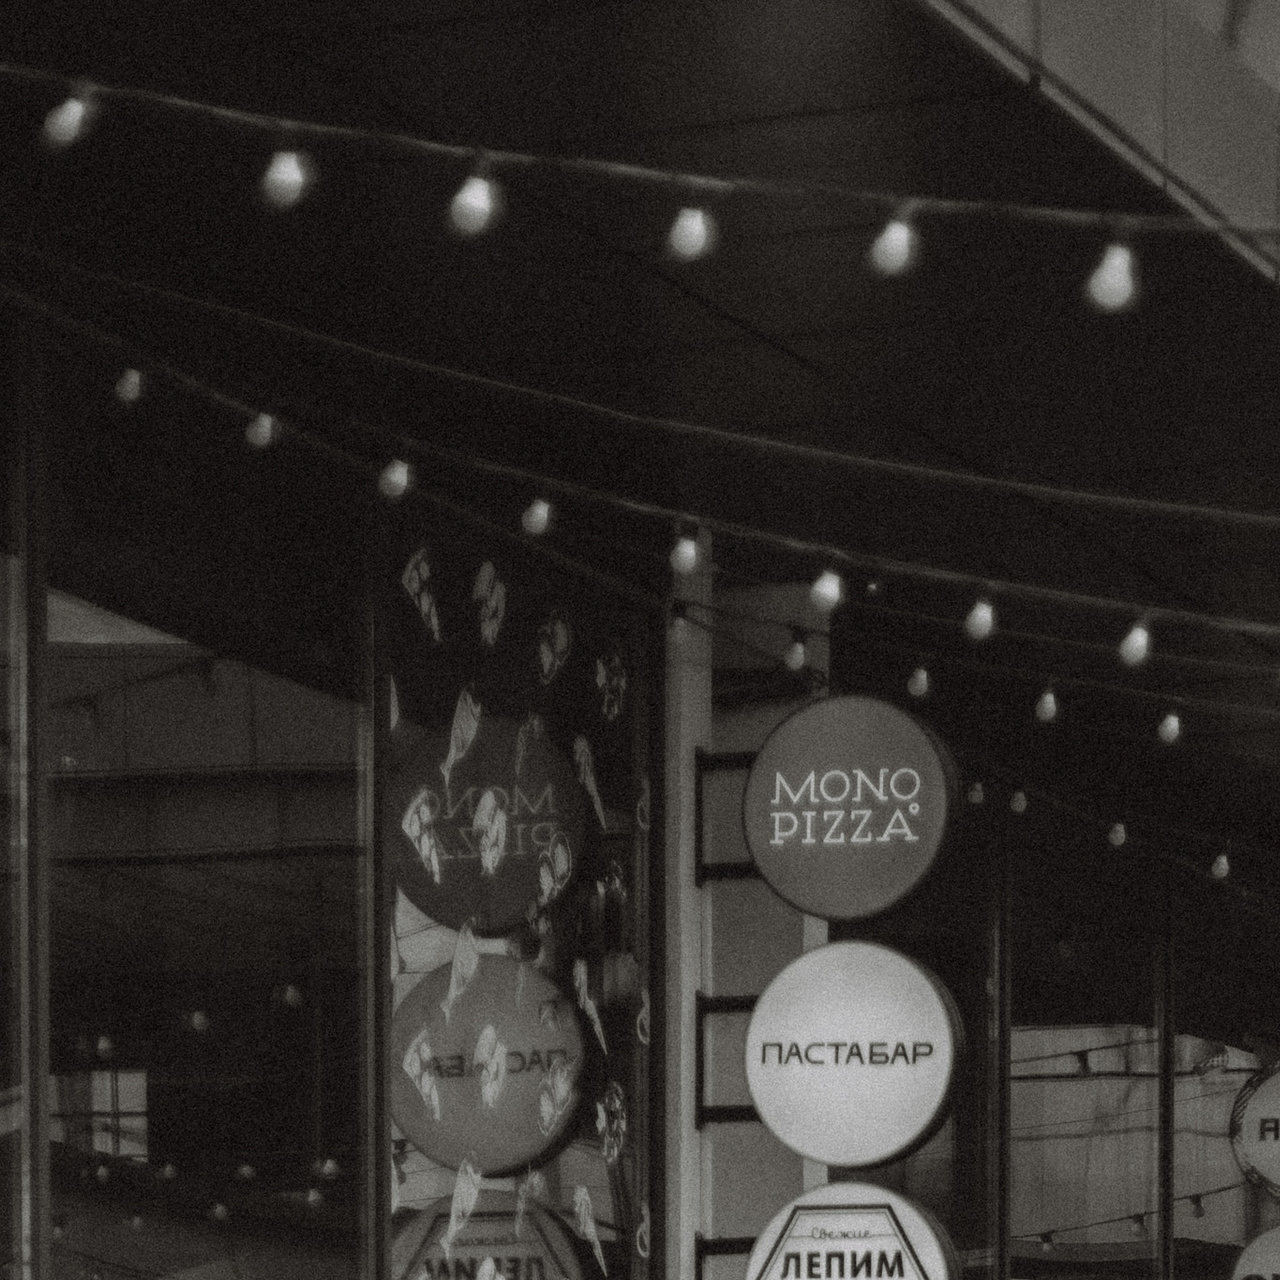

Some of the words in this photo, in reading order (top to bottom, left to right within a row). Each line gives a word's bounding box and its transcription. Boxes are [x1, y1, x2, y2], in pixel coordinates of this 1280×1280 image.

[770, 767, 920, 804] MONO
[769, 808, 919, 844] PIZZA
[761, 1041, 934, 1065] ПАСТАБАР
[811, 1227, 870, 1239] Свежие
[781, 1252, 904, 1279] ЛЕПИМ
